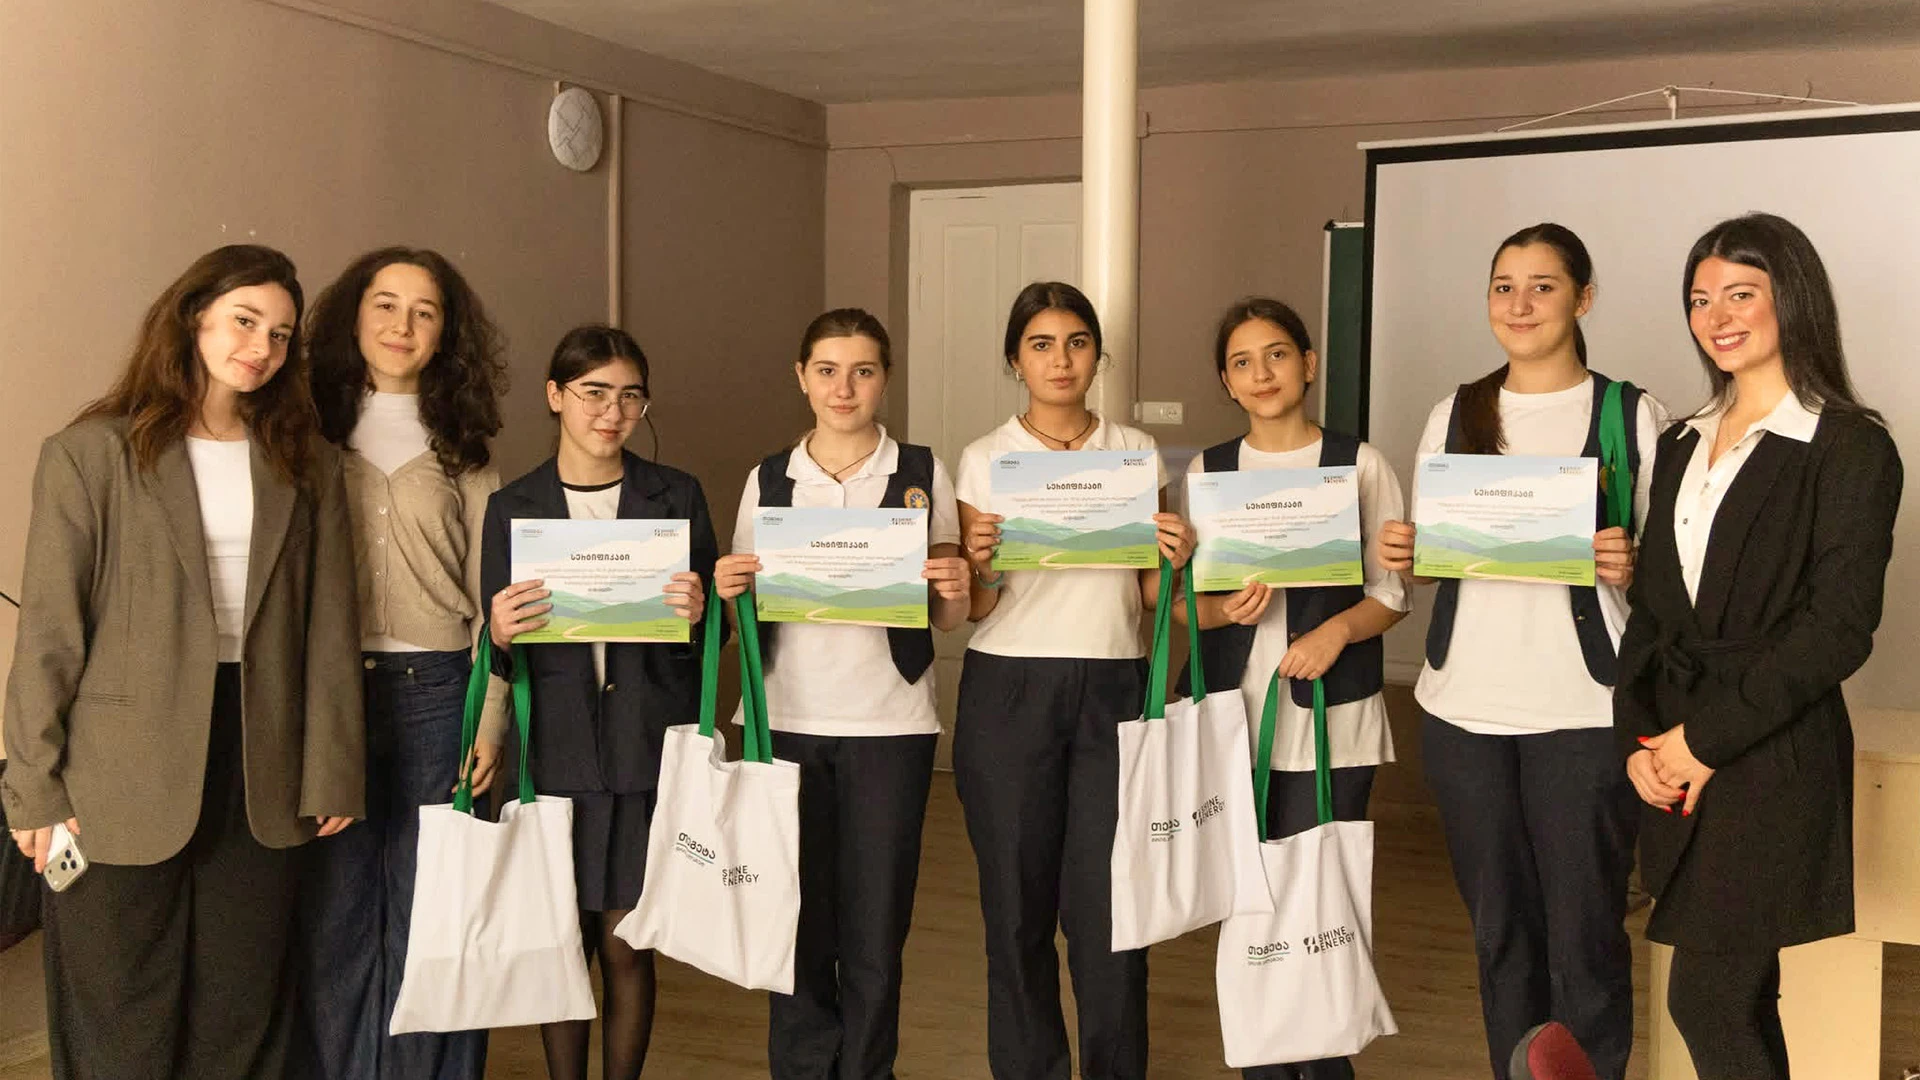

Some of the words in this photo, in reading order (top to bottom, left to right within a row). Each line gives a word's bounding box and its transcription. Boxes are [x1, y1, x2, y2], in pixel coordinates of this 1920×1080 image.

[722, 865, 748, 878] SHNE
[1318, 926, 1346, 942] SHINE
[1320, 931, 1355, 951] ENERGY
